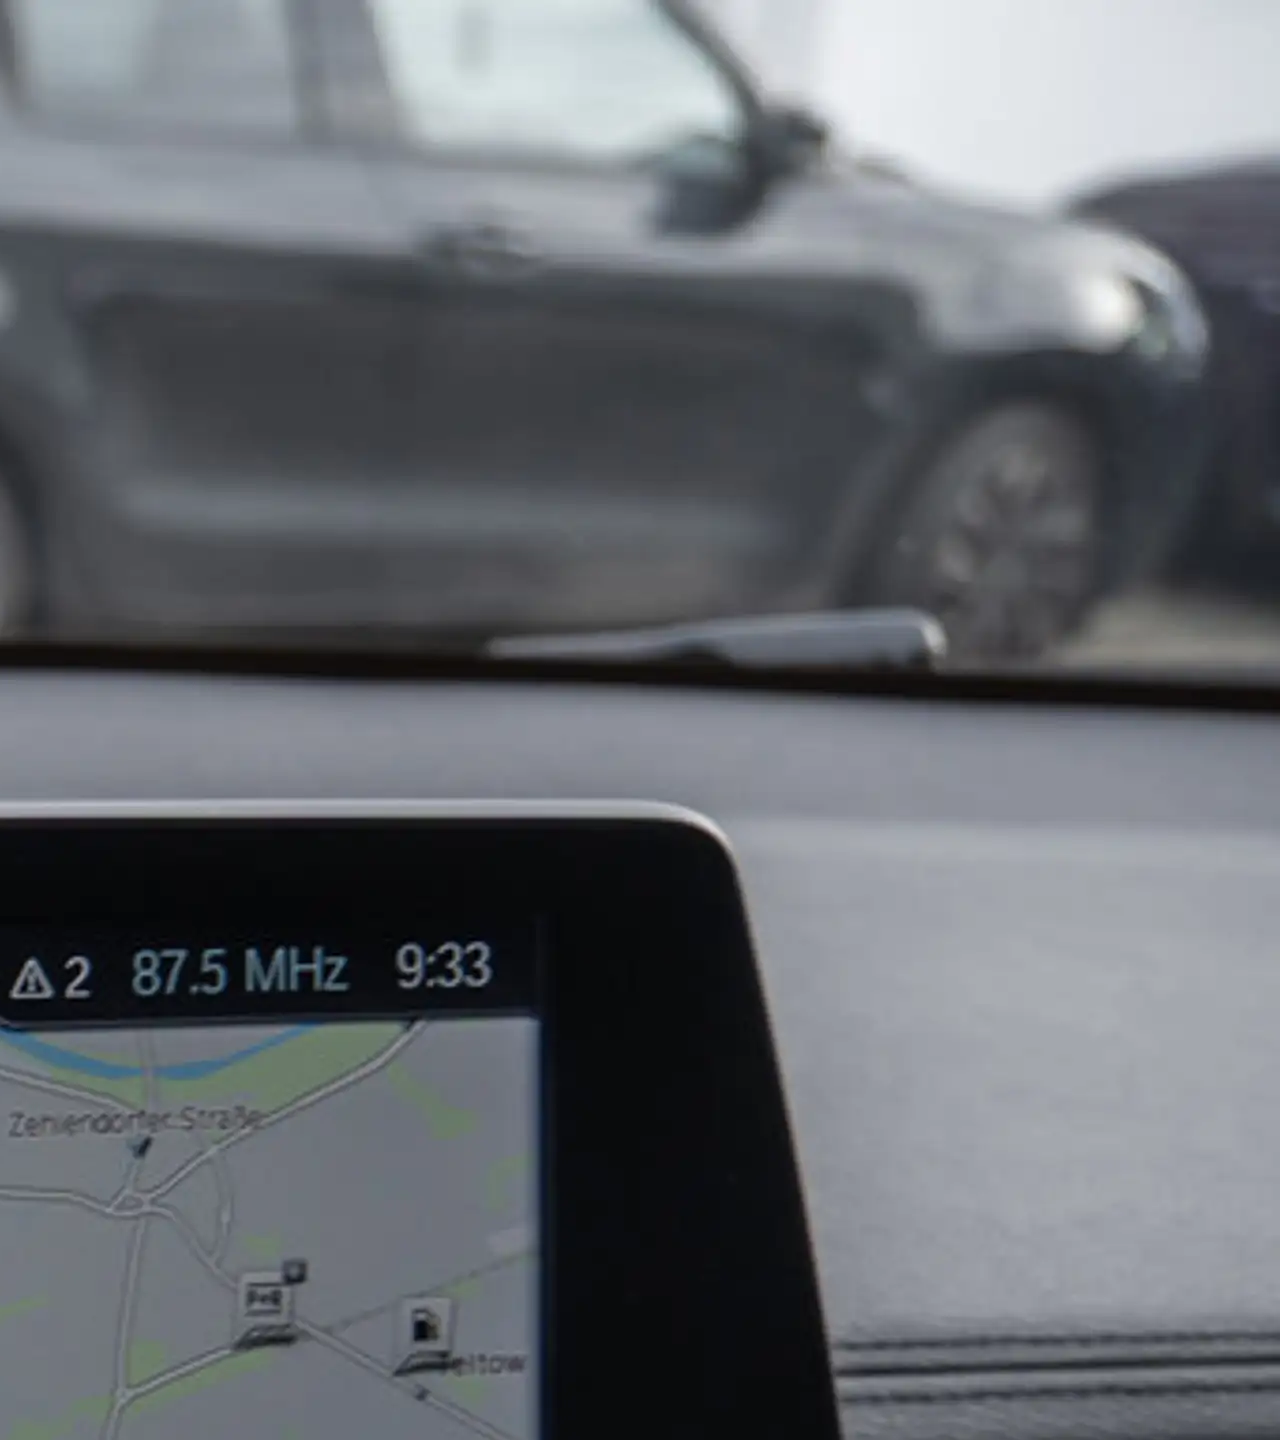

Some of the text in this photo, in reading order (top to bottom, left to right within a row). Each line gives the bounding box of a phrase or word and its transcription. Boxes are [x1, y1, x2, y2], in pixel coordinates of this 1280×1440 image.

[64, 955, 91, 998] 2
[131, 946, 350, 996] 87.5 MHz
[395, 941, 493, 989] 9:33
